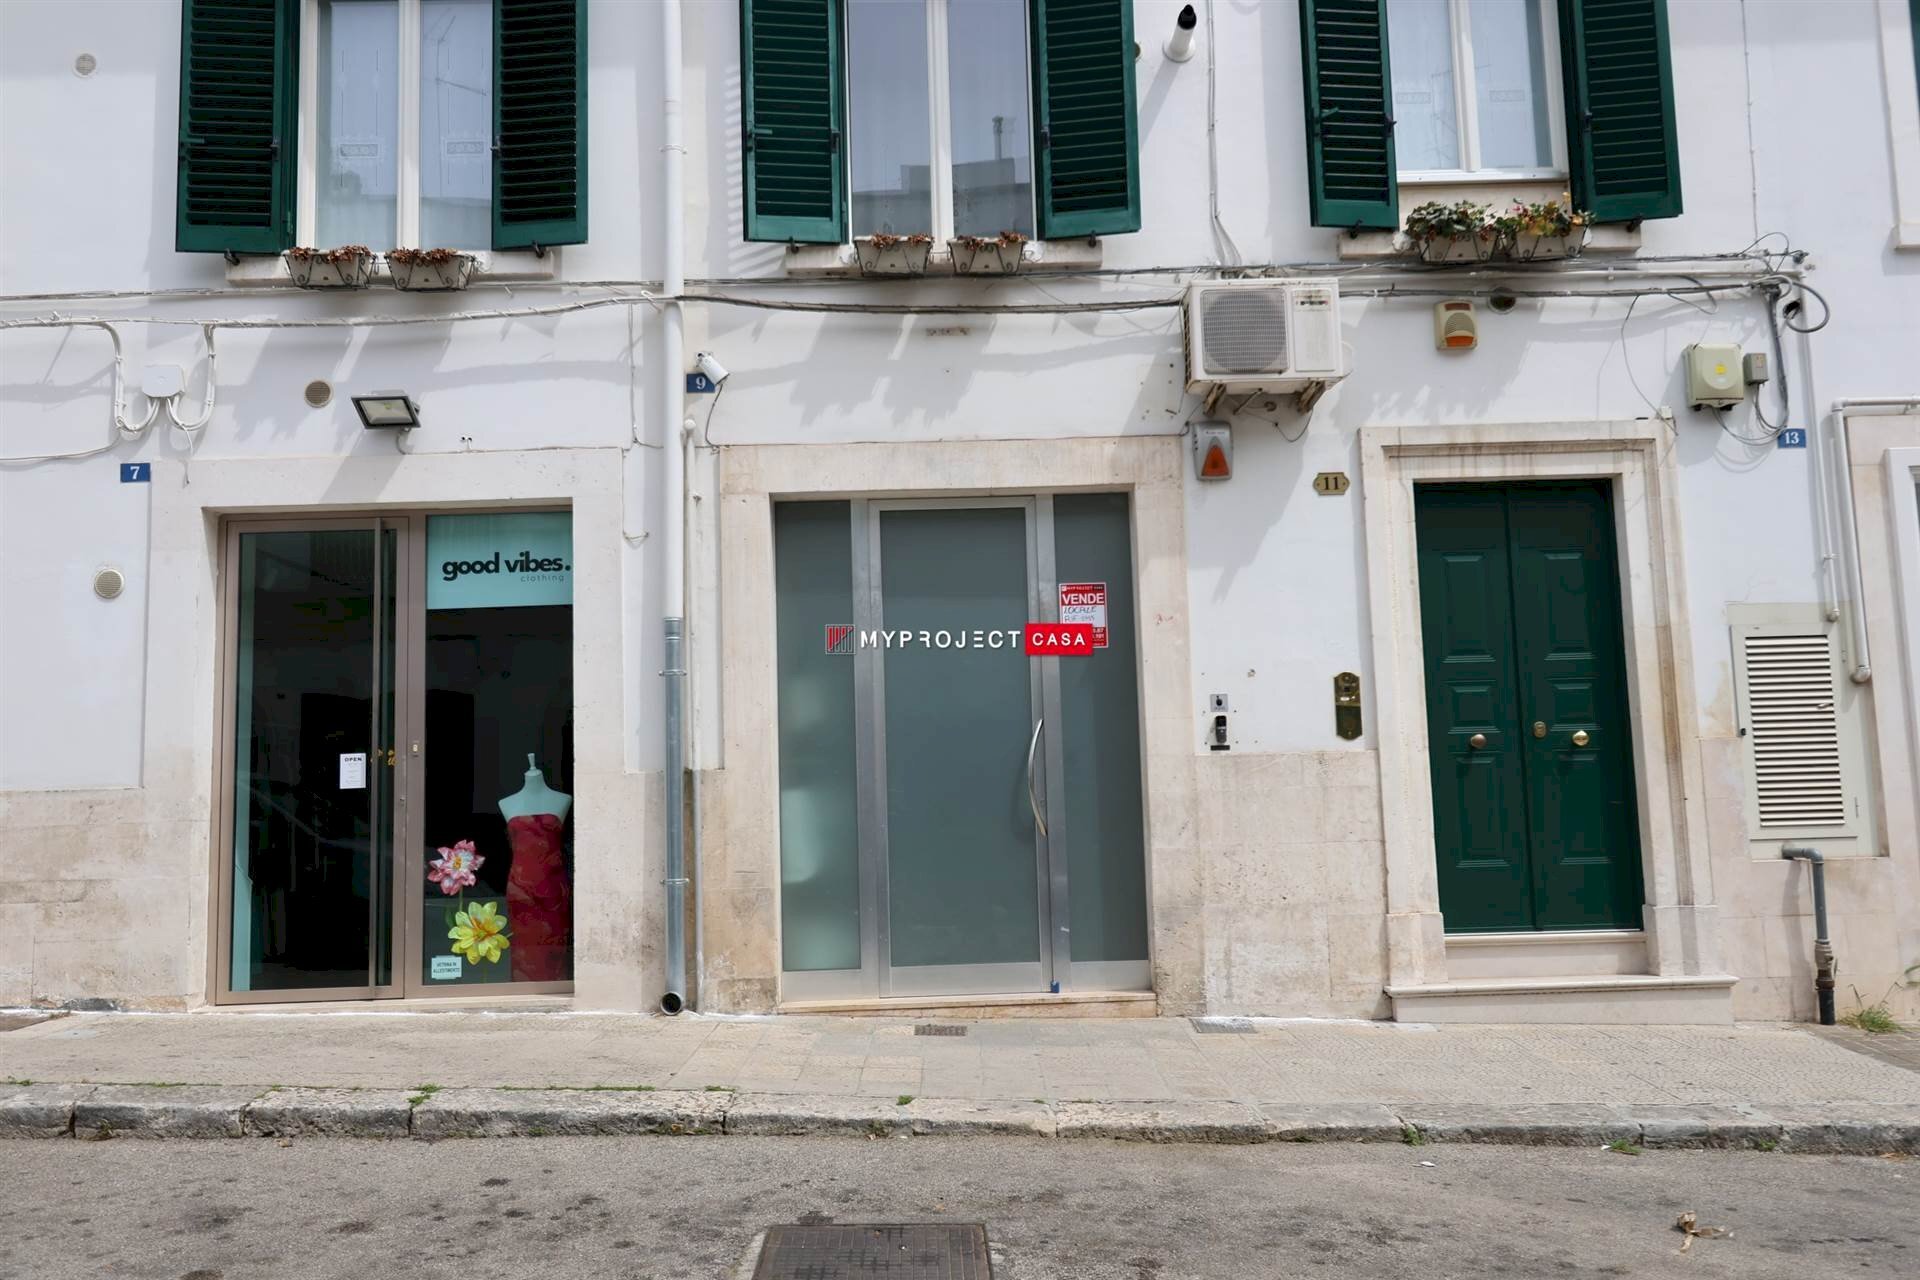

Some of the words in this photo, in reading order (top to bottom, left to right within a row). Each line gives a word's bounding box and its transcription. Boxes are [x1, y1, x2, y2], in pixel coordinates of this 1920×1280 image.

[695, 376, 706, 390] 9
[1785, 431, 1800, 444] 13
[130, 465, 140, 480] 7
[1324, 476, 1338, 490] 11
[442, 551, 500, 581] good
[504, 550, 571, 573] vibes.
[520, 574, 565, 583] clothing
[1062, 592, 1105, 605] VENDE
